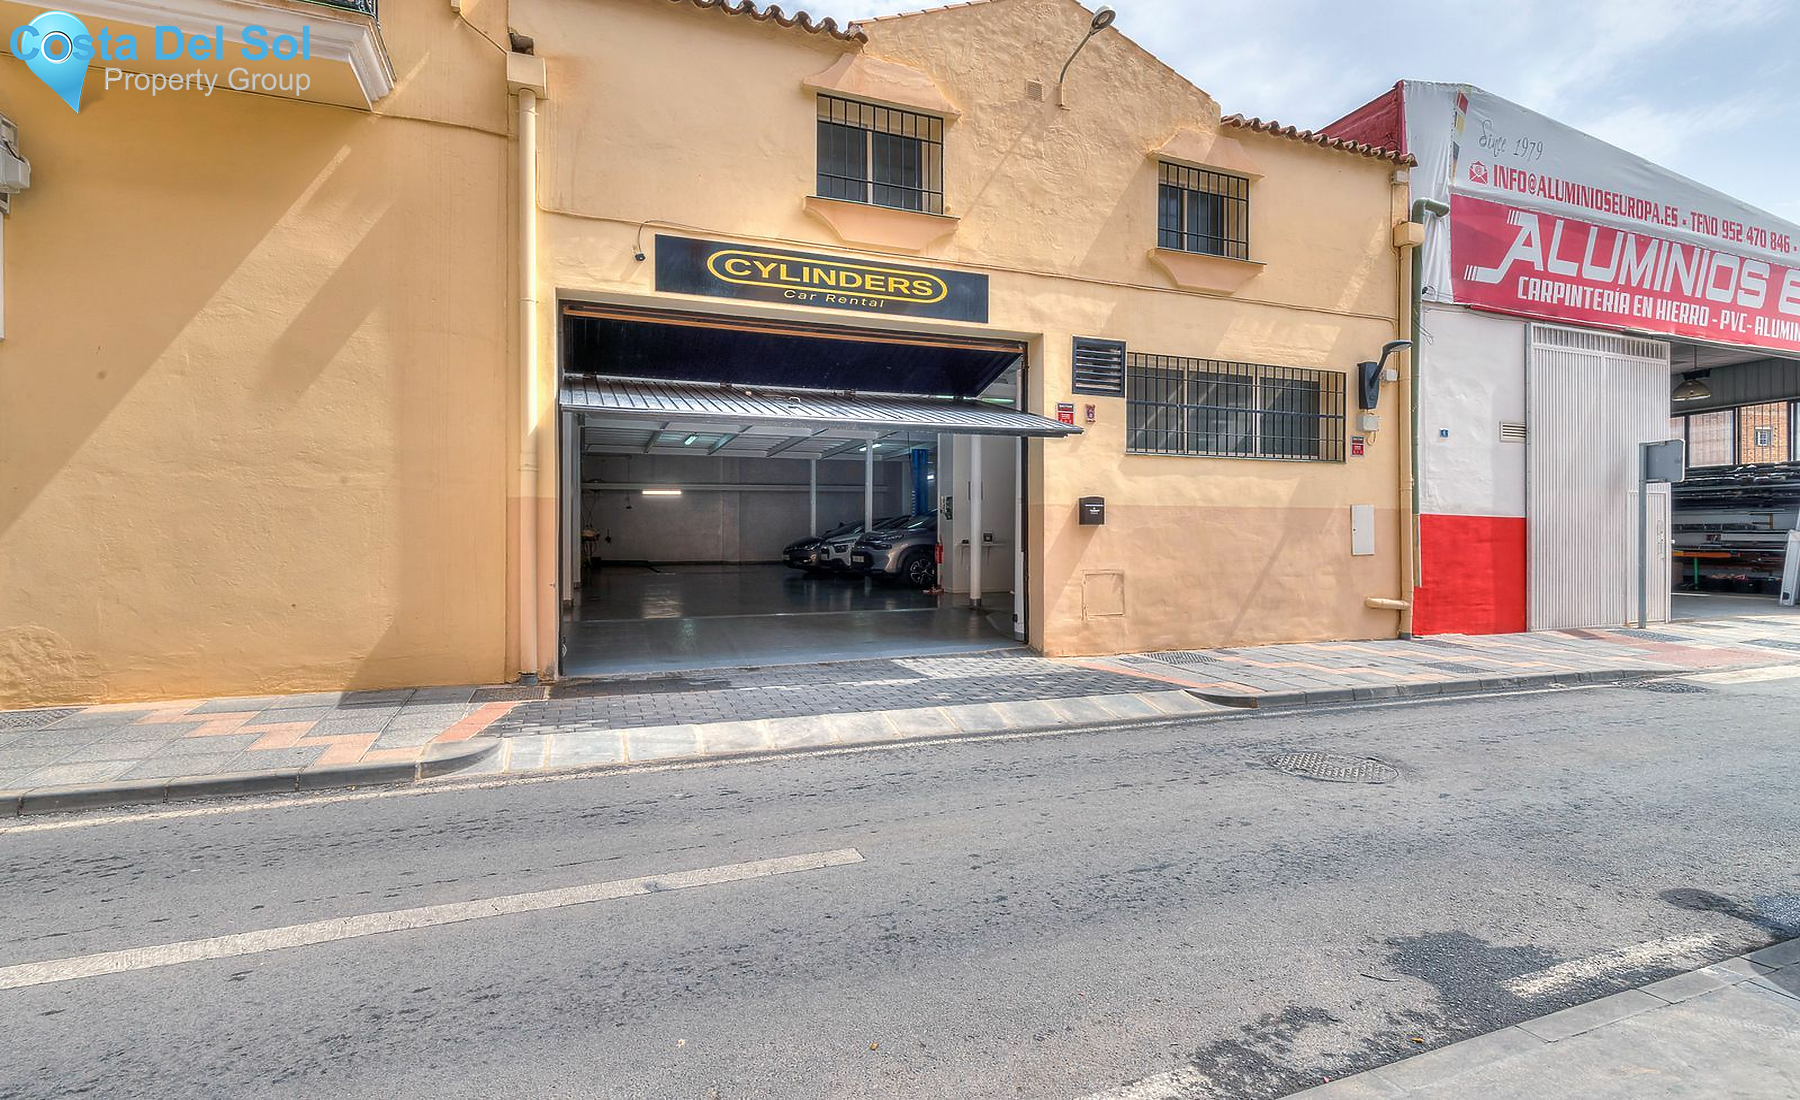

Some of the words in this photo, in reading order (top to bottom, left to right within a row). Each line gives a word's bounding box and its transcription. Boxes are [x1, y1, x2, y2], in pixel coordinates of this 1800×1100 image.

[1513, 136, 1544, 161] 1979
[1493, 164, 1679, 228] INFO@ALUMINIOSEUROPA.ES
[1721, 219, 1743, 243] 952
[1746, 226, 1767, 249] 470
[1770, 231, 1791, 254] 846
[724, 258, 933, 297] CYLINDERS
[1464, 209, 1771, 310] ALUMINIOS
[783, 289, 817, 302] Car
[826, 293, 885, 308] Rental
[1517, 276, 1630, 316] CARPINTERÍA
[1633, 294, 1653, 319] EN
[1655, 298, 1710, 327] HIERRO
